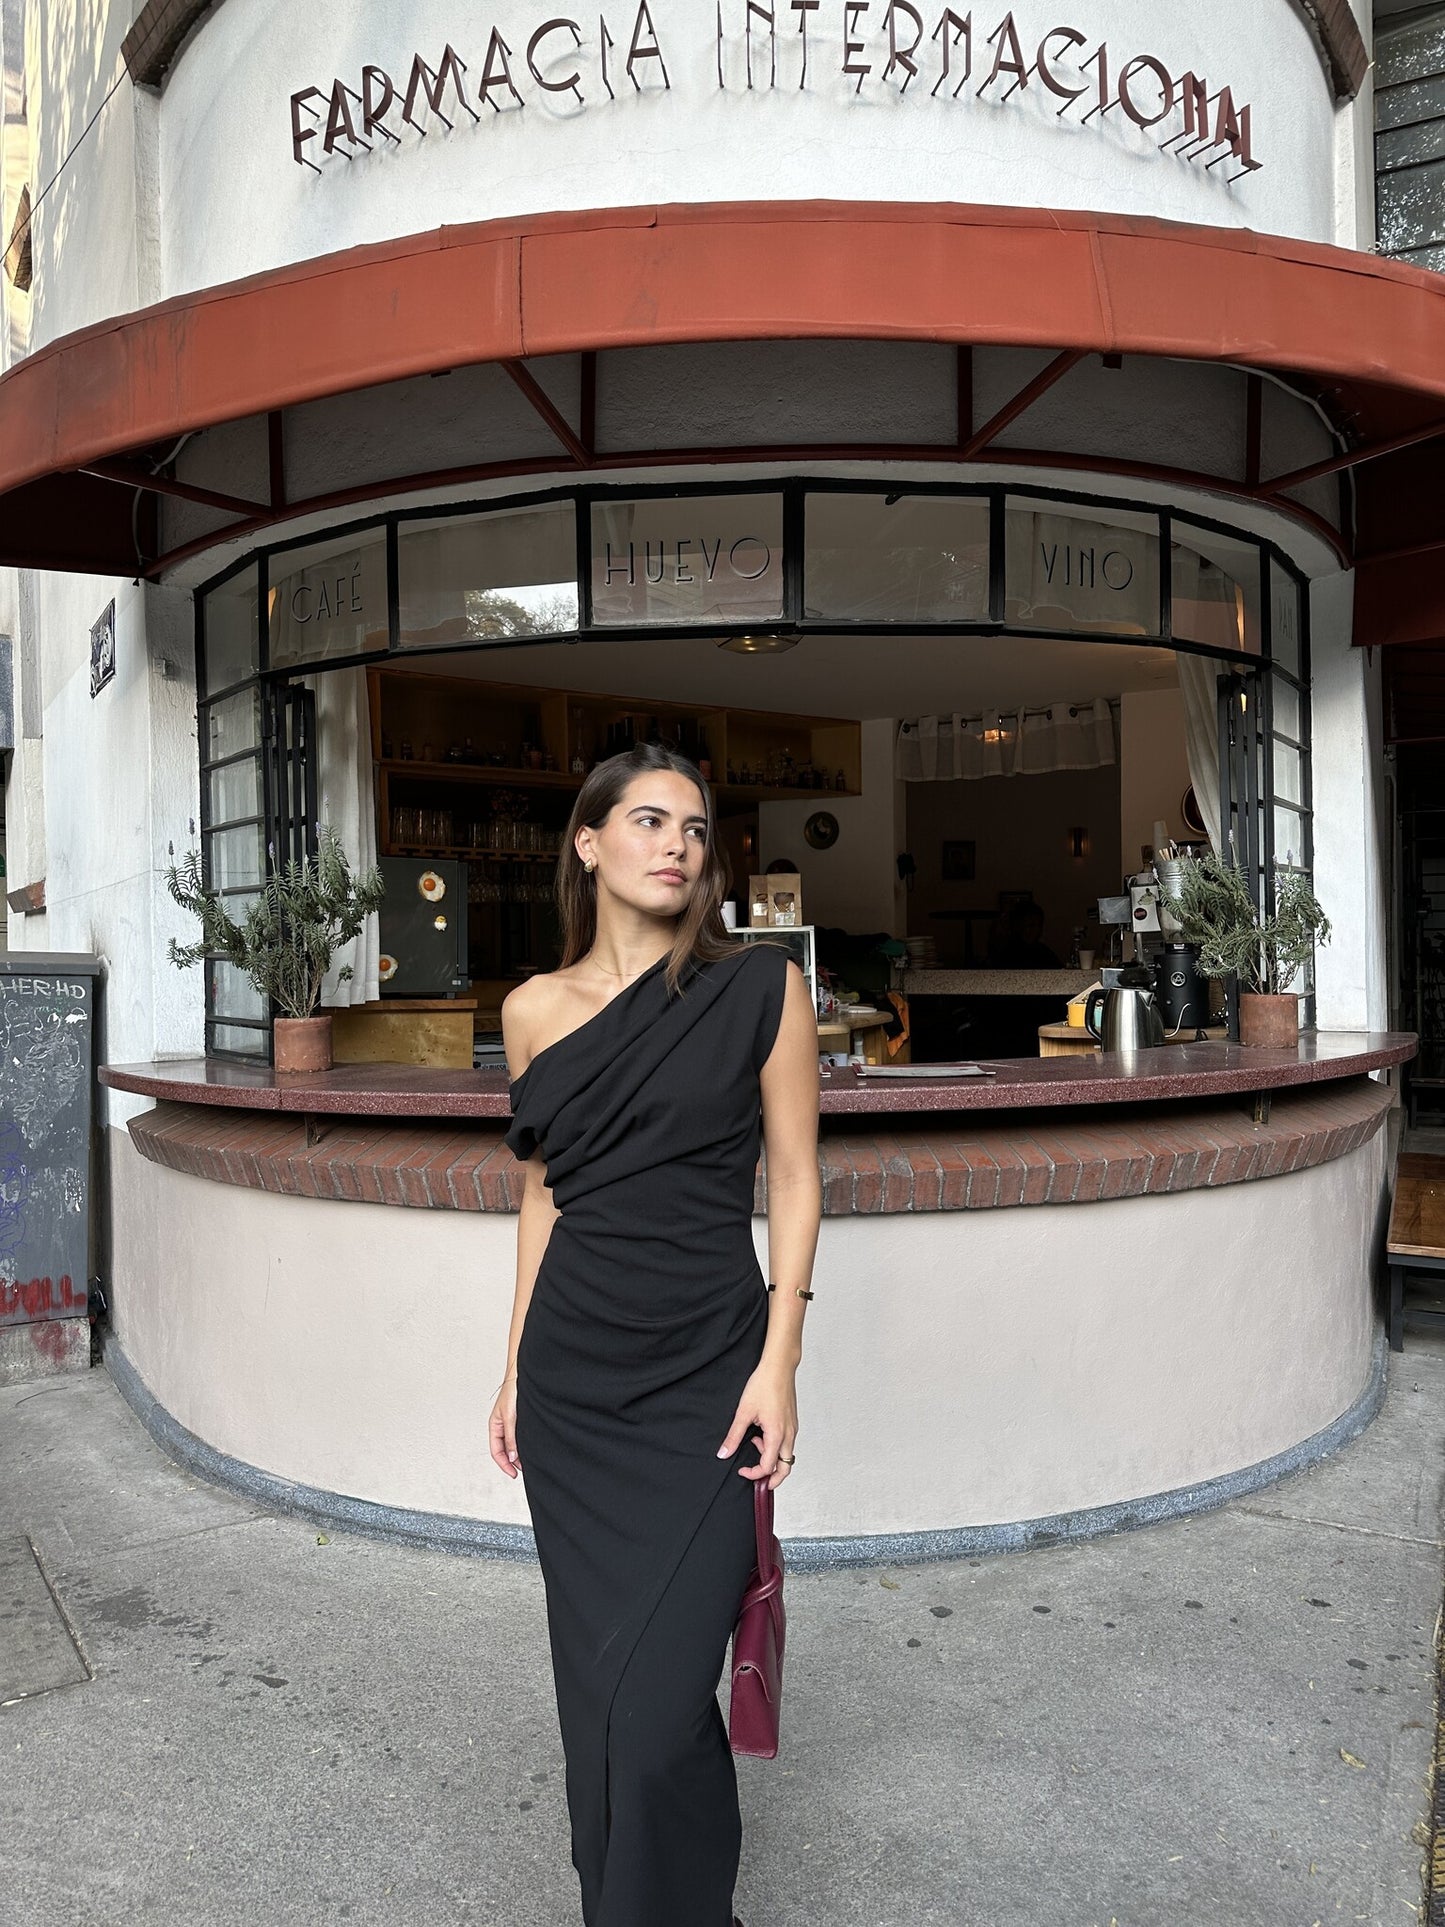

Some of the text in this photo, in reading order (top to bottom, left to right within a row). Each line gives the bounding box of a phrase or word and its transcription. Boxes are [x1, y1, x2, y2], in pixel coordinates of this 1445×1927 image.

[290, 0, 1263, 171] FARMACIA INTERNACIONAL
[603, 536, 771, 586] HUEVO
[1040, 542, 1133, 590] VINO
[290, 562, 364, 624] CAFÉ
